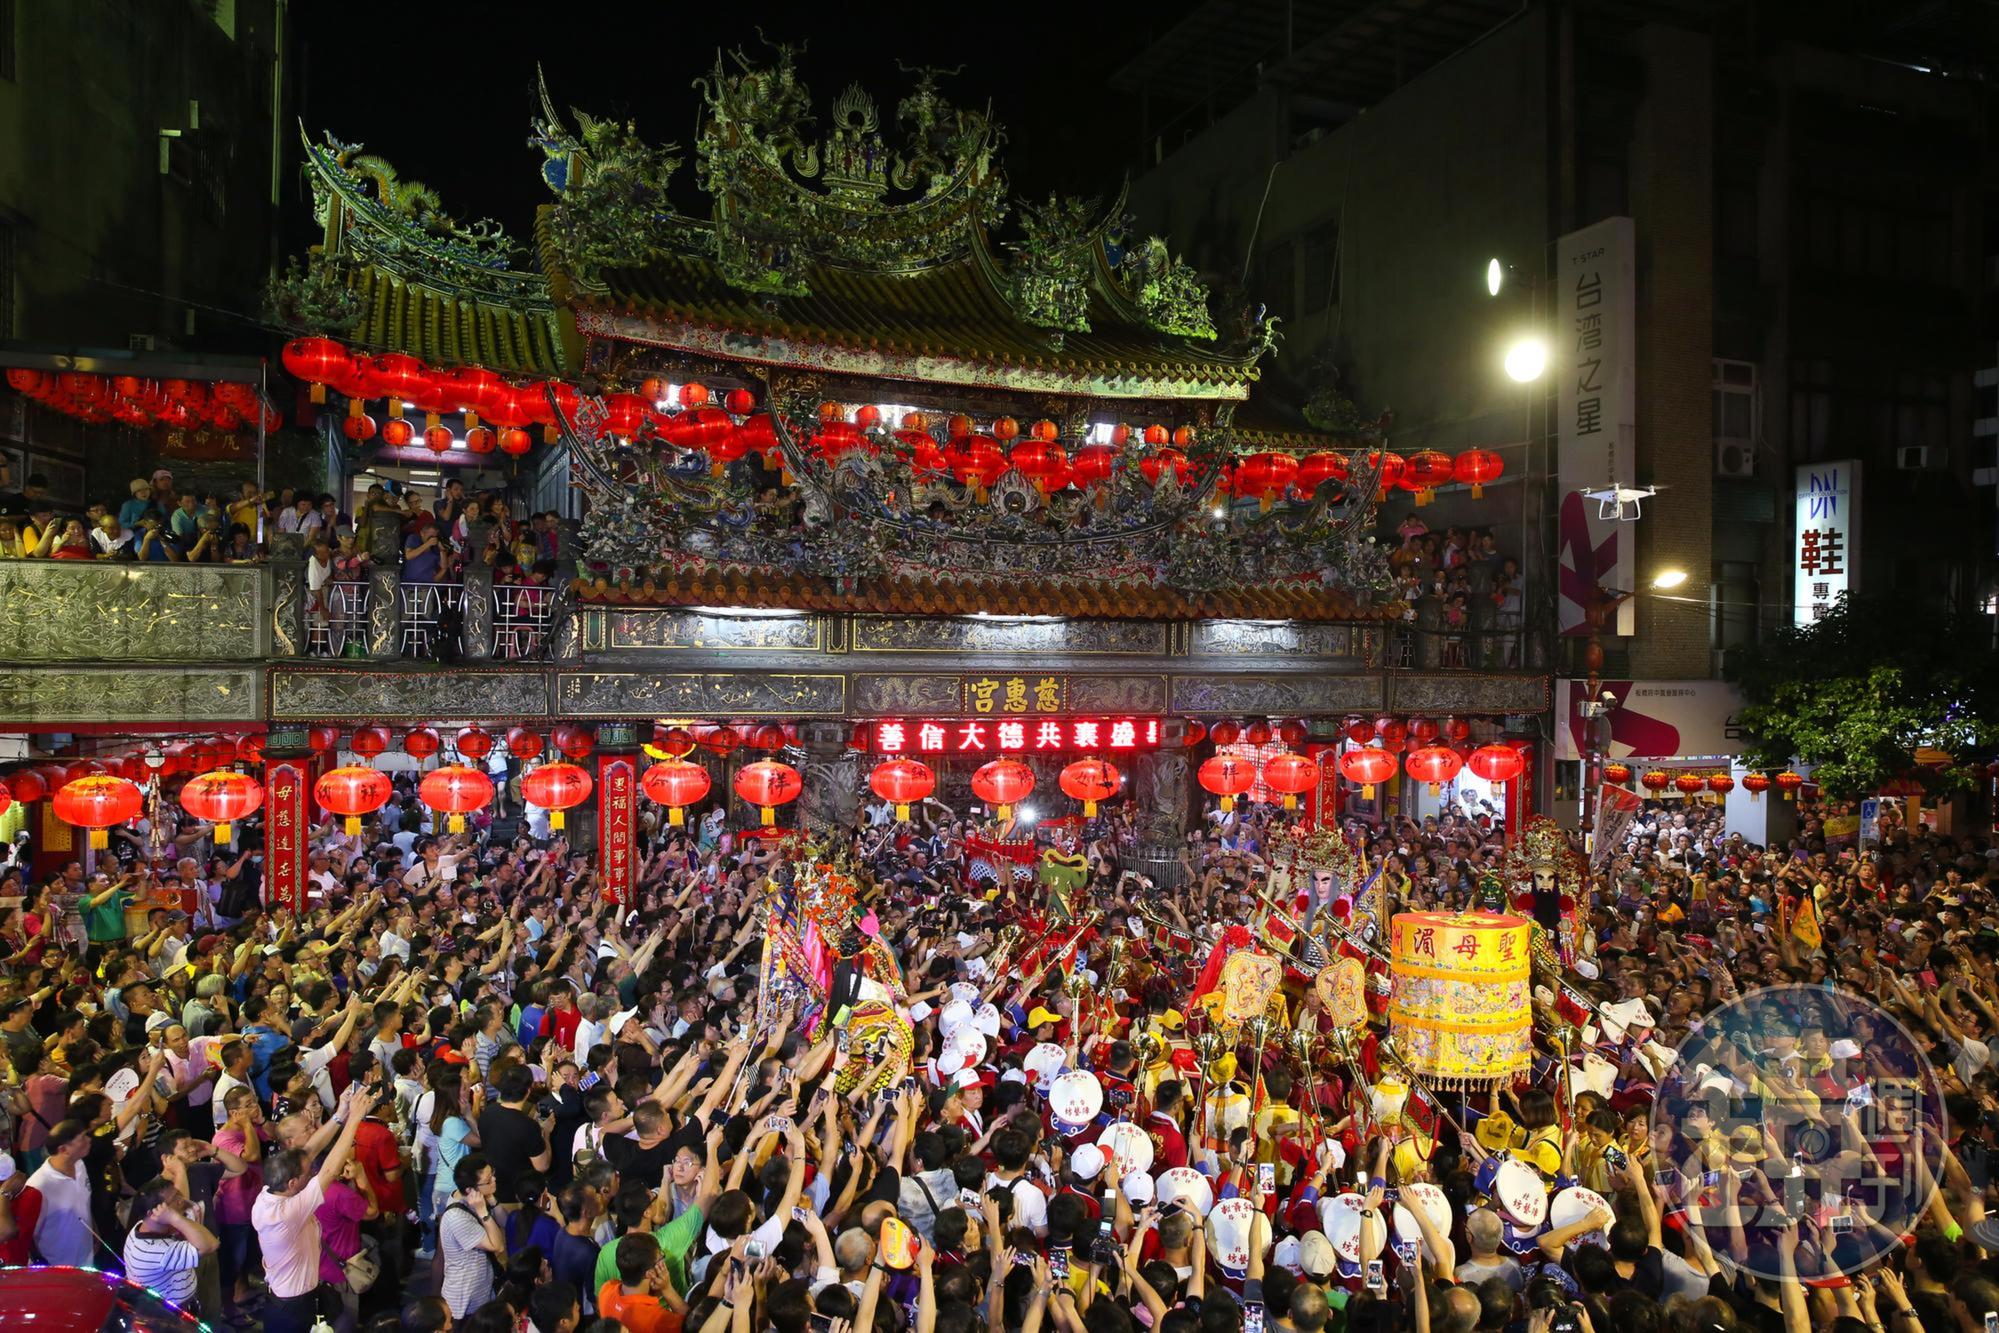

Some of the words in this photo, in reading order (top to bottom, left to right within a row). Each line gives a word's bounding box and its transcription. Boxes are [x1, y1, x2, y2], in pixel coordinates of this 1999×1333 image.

[1576, 271, 1602, 437] 台灣之星
[1810, 468, 1838, 520] DN
[1801, 527, 1844, 576] 鞋
[971, 677, 1061, 713] 慈惠宮
